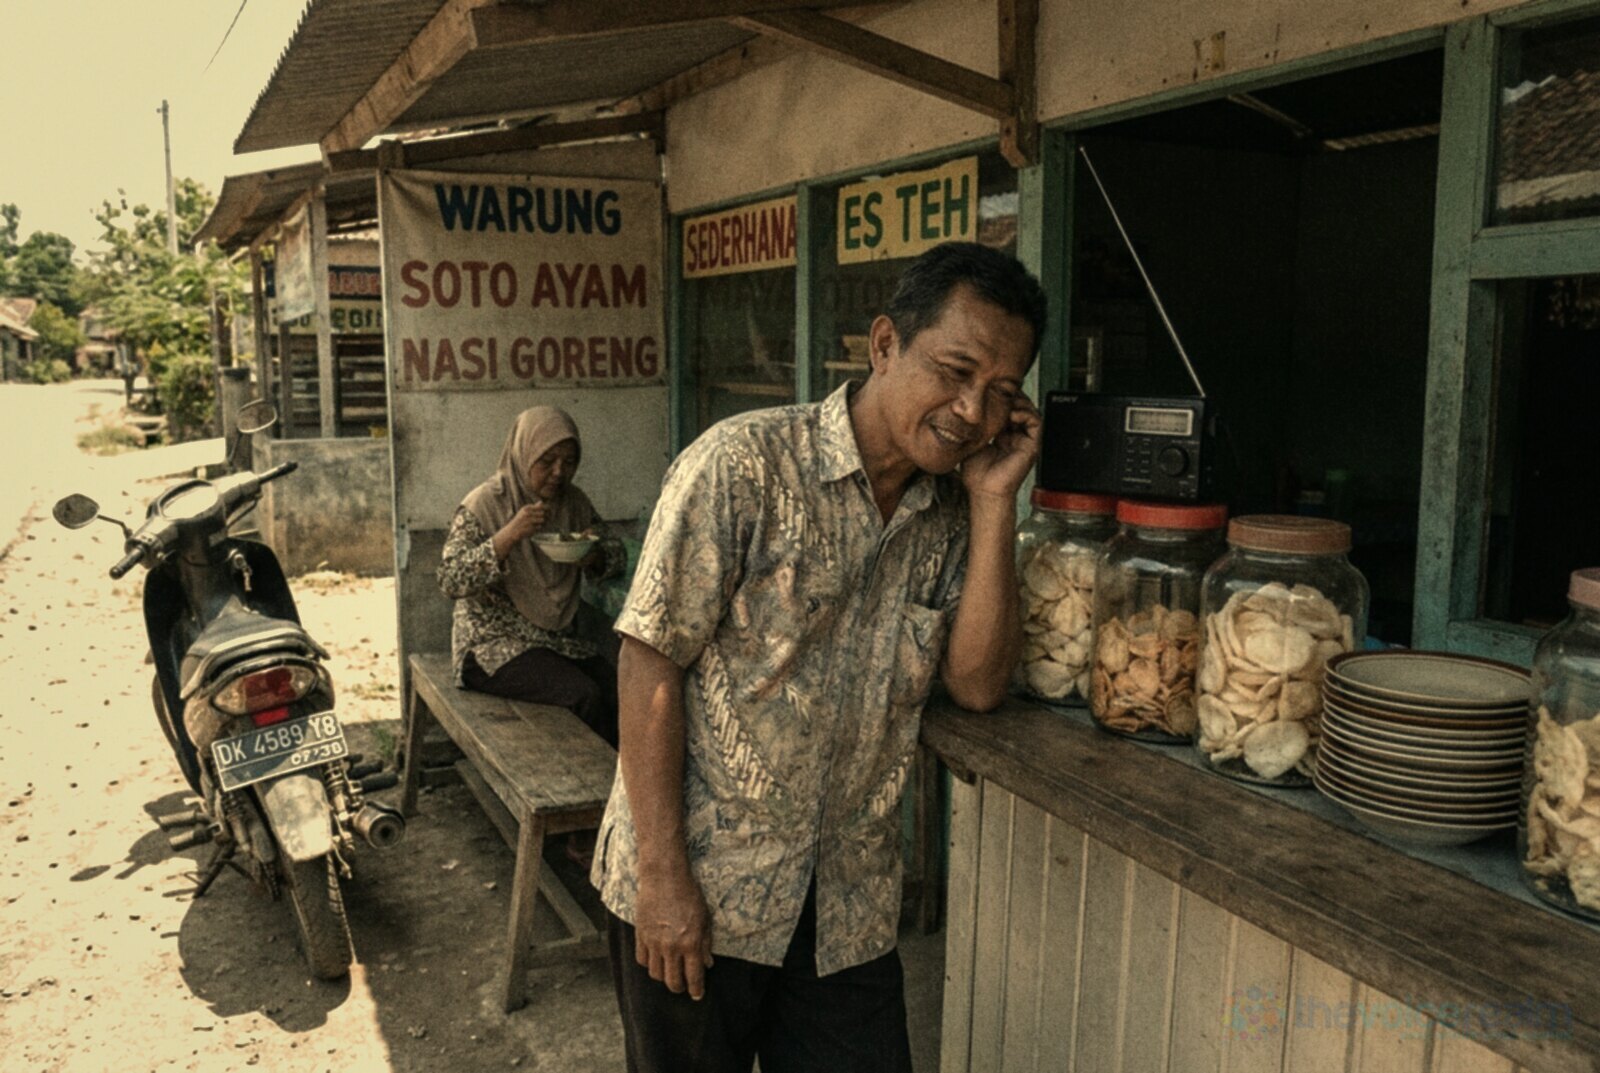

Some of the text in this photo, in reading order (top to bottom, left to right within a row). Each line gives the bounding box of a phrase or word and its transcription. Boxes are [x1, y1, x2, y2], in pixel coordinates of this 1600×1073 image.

[434, 183, 622, 235] WARUNG
[844, 174, 970, 251] ES TEH
[686, 203, 797, 273] SEDERHANA
[401, 260, 647, 309] SOTO AYAM
[403, 336, 658, 382] NASI GORENG
[217, 740, 247, 766] DK
[254, 724, 304, 754] 4589
